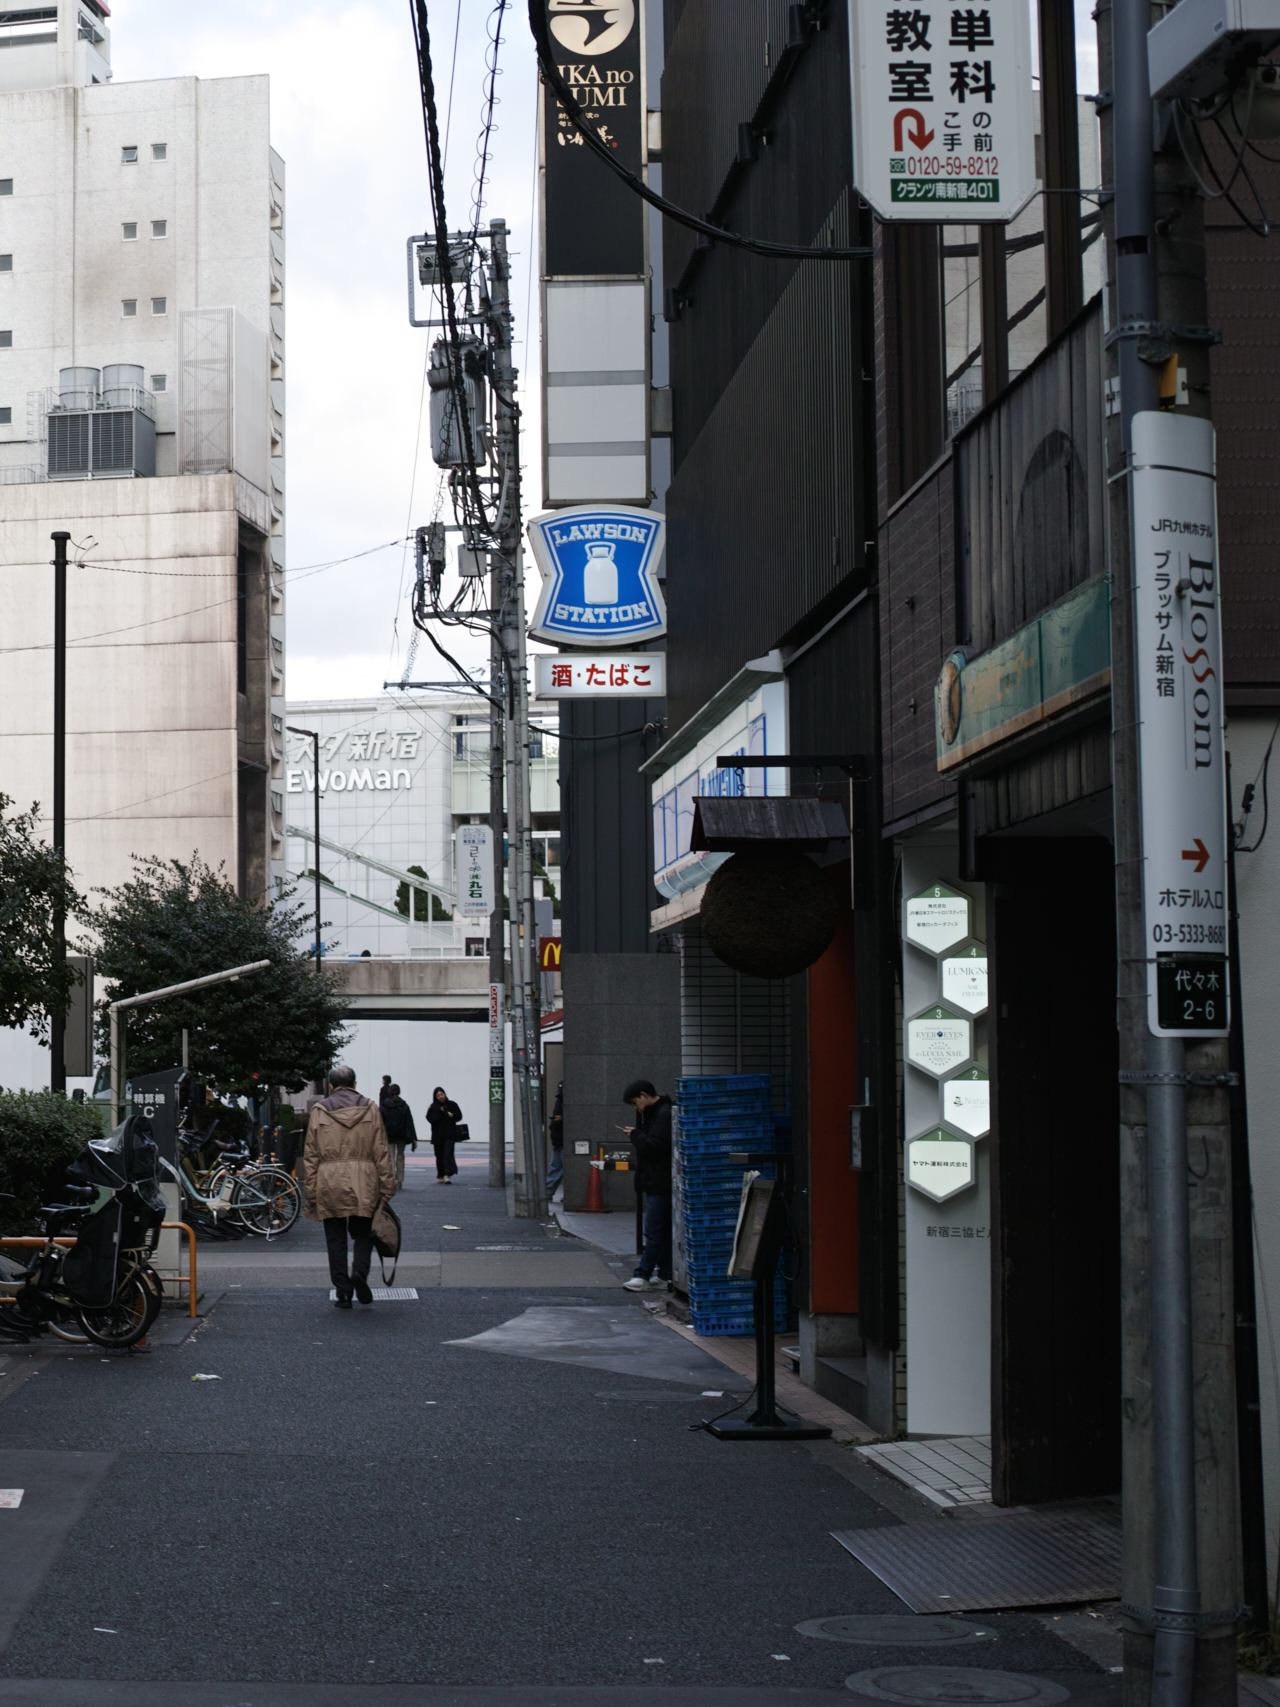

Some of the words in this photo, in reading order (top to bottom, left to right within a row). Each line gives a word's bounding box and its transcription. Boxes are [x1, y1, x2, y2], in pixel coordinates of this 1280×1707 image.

[886, 0, 934, 102] 教室
[949, 0, 996, 103] 単科
[605, 70, 634, 84] no
[556, 86, 628, 107] UMI
[908, 156, 999, 176] 0120-59-8212
[896, 182, 994, 199] クランツ南新宿401
[552, 523, 648, 547] LAWSON
[1151, 518, 1213, 538] JR九州ホテル
[554, 601, 650, 624] STATION
[1154, 550, 1175, 698] ブラッサム新宿
[1182, 552, 1217, 772] Blossom
[551, 663, 652, 688] 酒・たばこ
[286, 727, 423, 763] スタ新宿
[286, 767, 412, 793] EWoMan
[934, 888, 940, 897] 5
[1158, 888, 1224, 909] ホテル入口
[971, 948, 977, 957] 4
[1175, 970, 1220, 991] 代々木
[936, 1009, 942, 1018] 3
[1183, 1000, 1216, 1020] 2-6
[972, 1070, 978, 1080] 2
[133, 1093, 166, 1104] 精算機
[143, 1106, 155, 1118] C
[913, 1160, 968, 1168] ヤマト運輸株式会社
[926, 1226, 991, 1238] 新宿三協ビ
